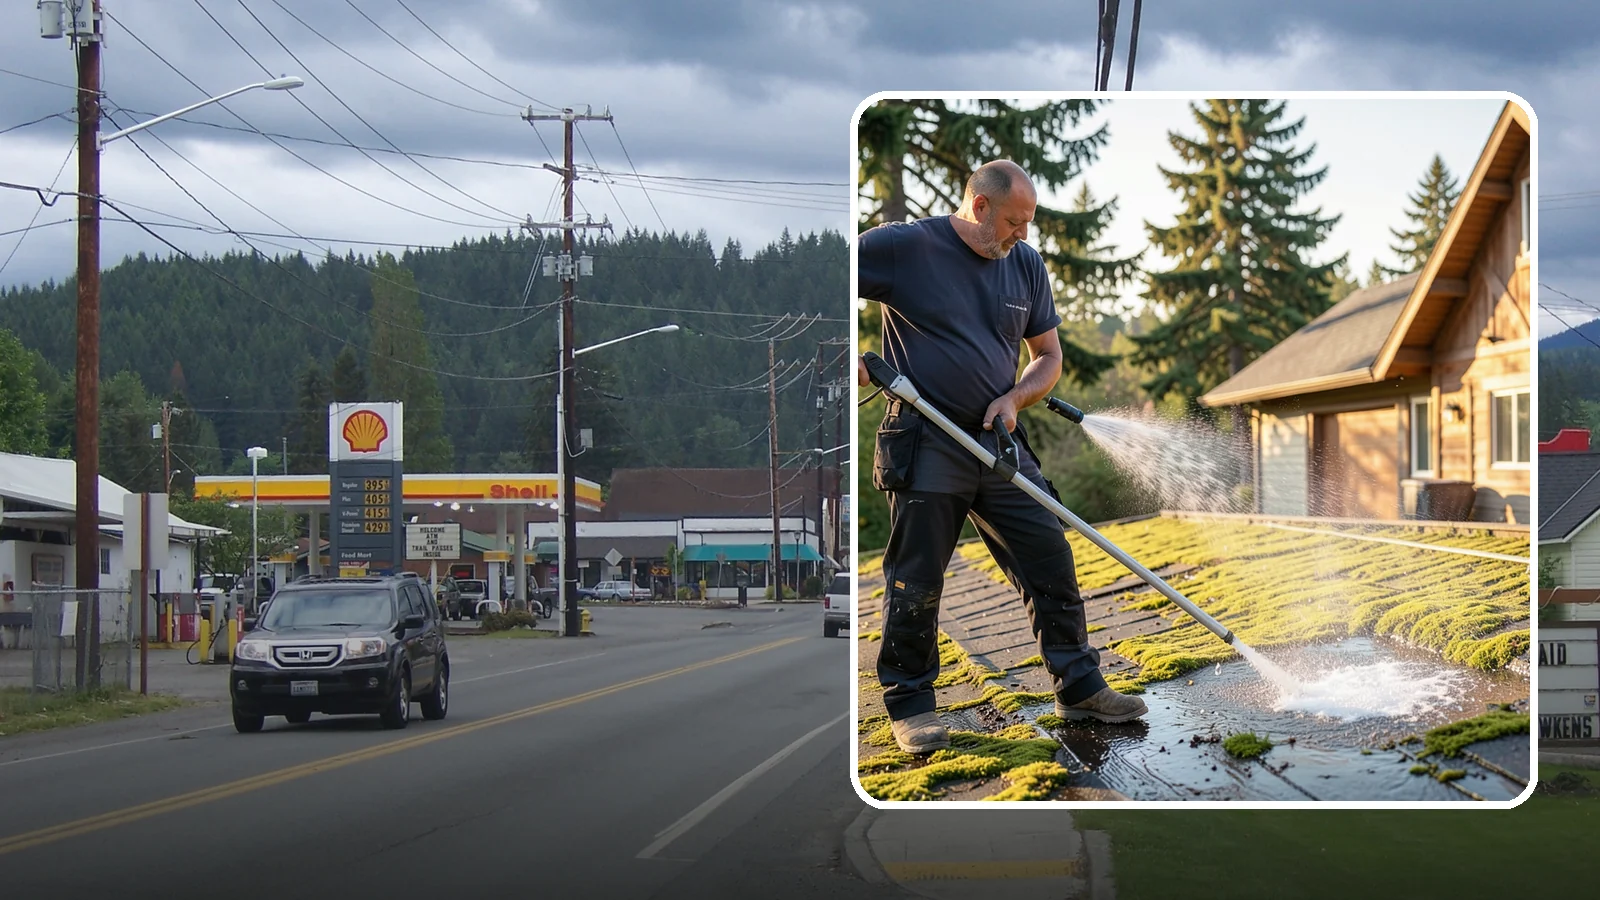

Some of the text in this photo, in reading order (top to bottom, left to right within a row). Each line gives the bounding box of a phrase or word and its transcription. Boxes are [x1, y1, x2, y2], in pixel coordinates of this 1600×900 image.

[366, 480, 383, 490] 395
[490, 484, 547, 499] Shell
[366, 494, 383, 504] 405
[366, 508, 383, 517] 415
[366, 522, 383, 532] 429
[1538, 642, 1567, 666] AID
